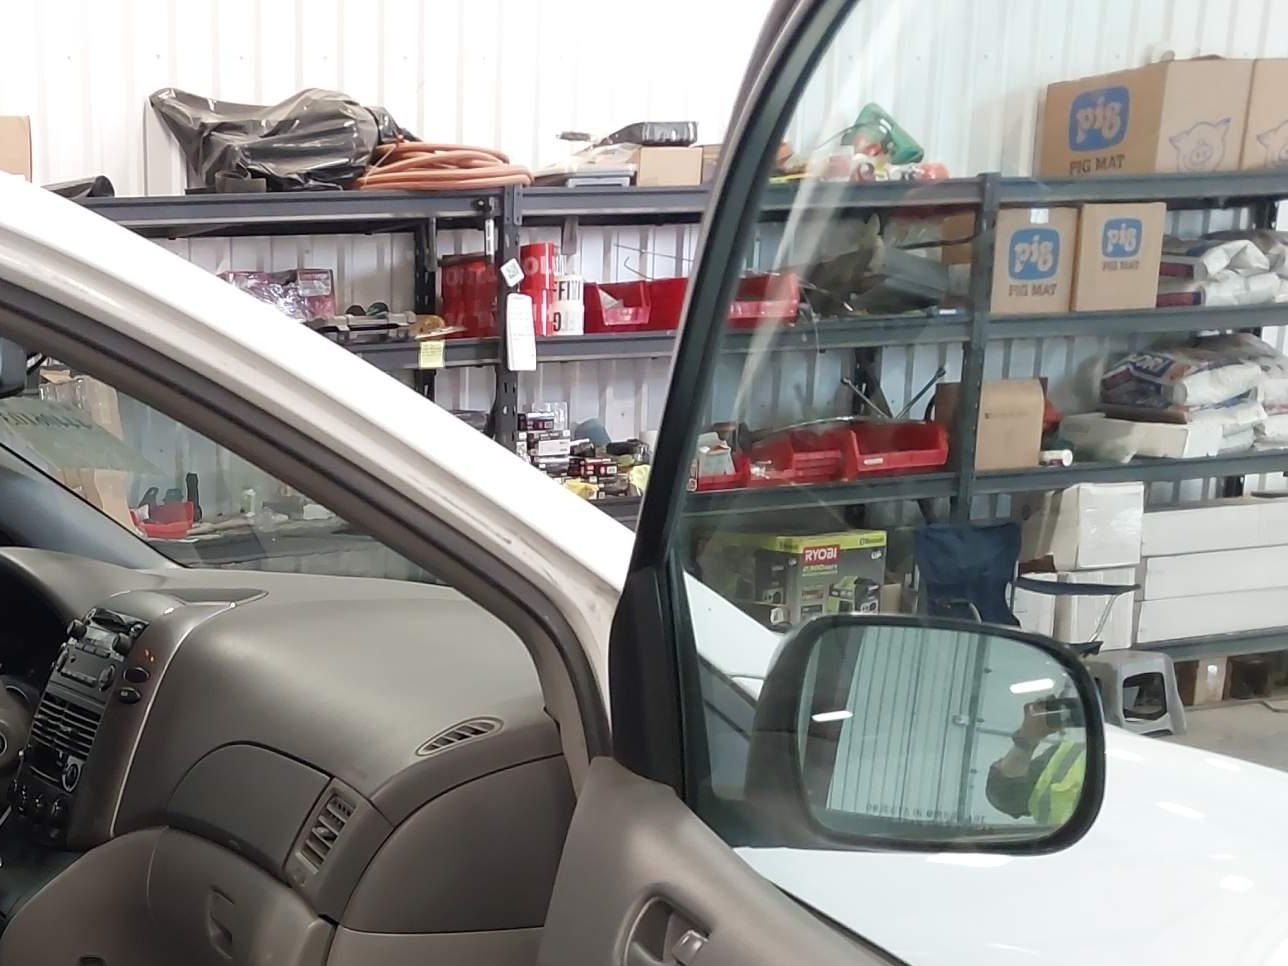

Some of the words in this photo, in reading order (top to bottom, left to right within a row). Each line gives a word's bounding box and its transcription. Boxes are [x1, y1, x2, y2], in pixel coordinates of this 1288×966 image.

[1076, 96, 1122, 144] pig
[1069, 159, 1092, 176] PIG
[1095, 153, 1125, 170] MAT
[1105, 223, 1136, 254] pig
[1014, 234, 1054, 273] pig
[1102, 261, 1118, 272] PIG
[1120, 259, 1140, 271] MAT
[1008, 284, 1029, 297] PIG
[1031, 283, 1058, 296] MAT
[804, 547, 838, 561] RYOBI
